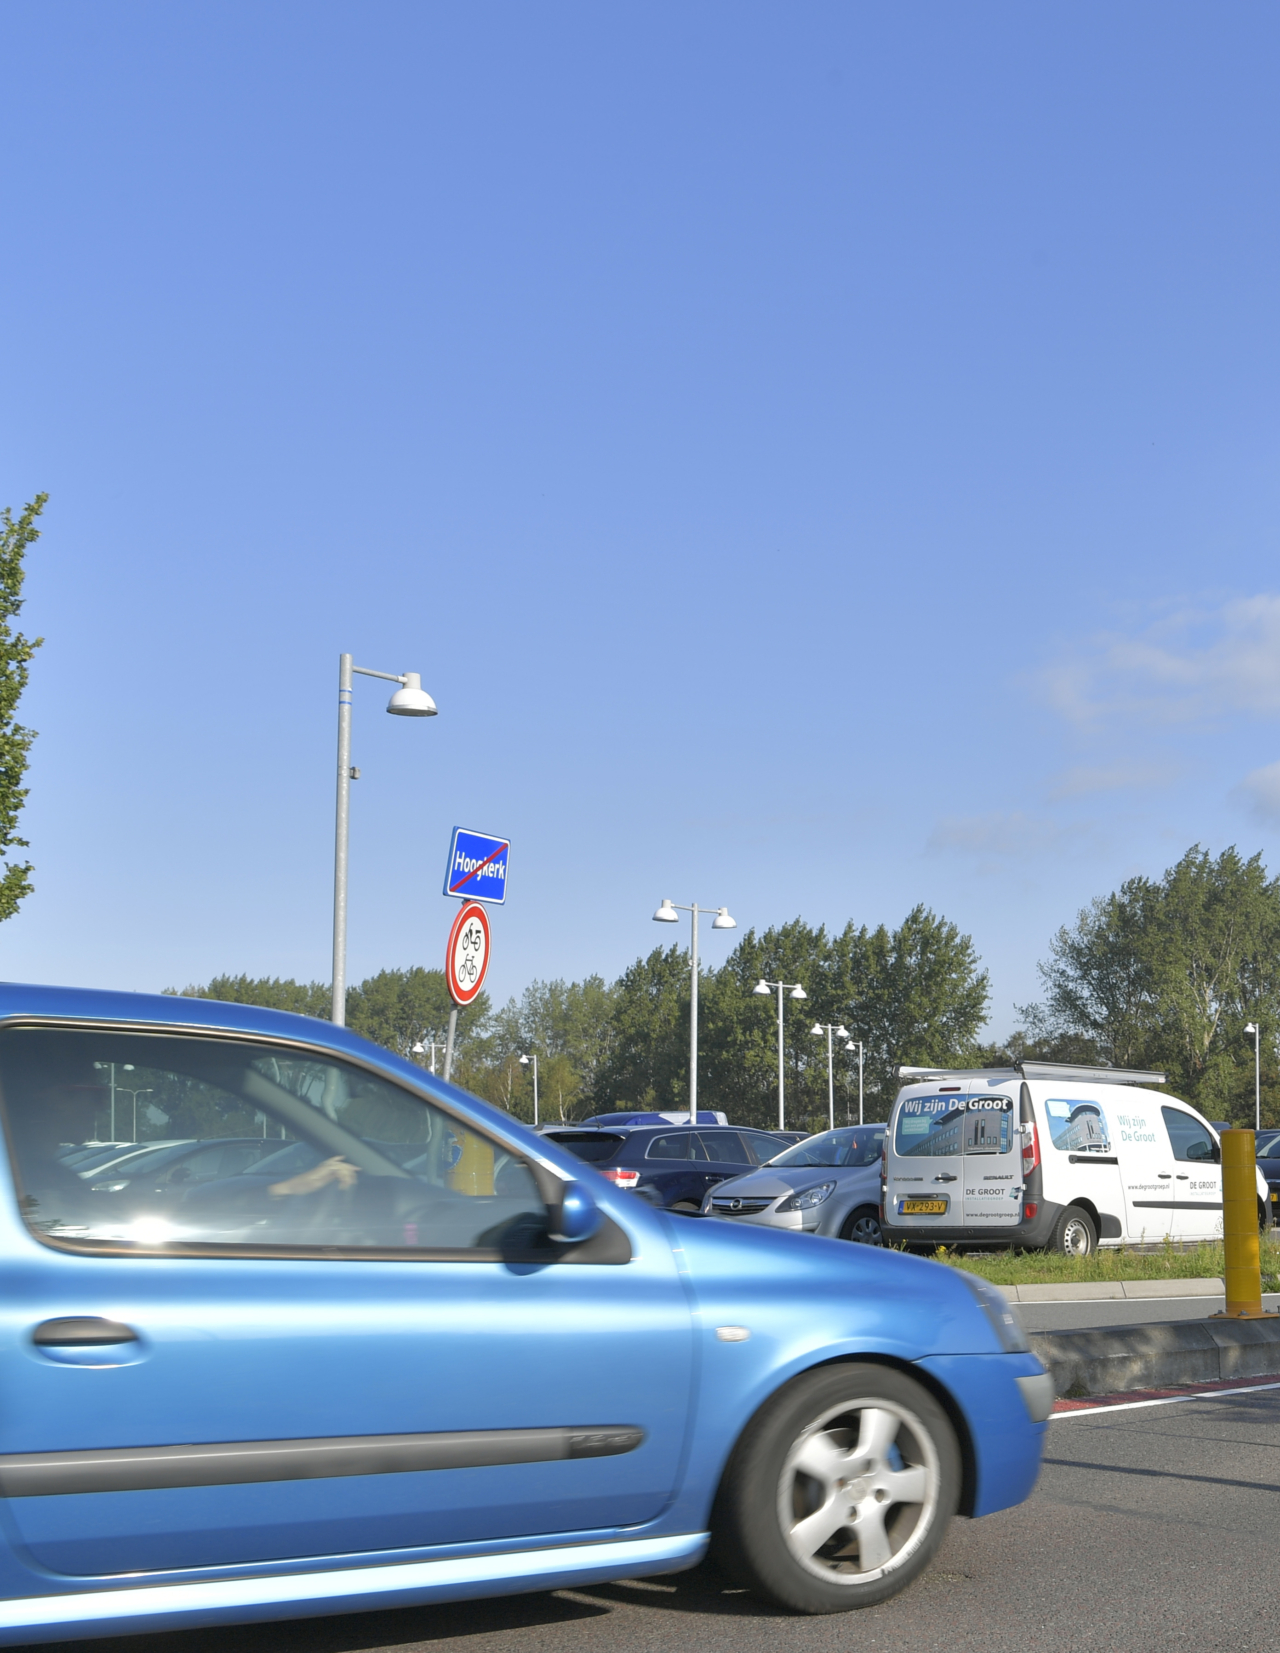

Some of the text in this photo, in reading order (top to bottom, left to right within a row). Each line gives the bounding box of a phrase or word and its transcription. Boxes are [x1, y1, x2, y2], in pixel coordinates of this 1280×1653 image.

[454, 850, 506, 881] Hoogkerk
[904, 1098, 1009, 1115] Wij zijn De Groot
[1117, 1115, 1146, 1129] Wij zijn
[1121, 1130, 1156, 1142] De Groot
[1198, 1181, 1216, 1189] GROOT
[906, 1202, 943, 1211] VX-293-V
